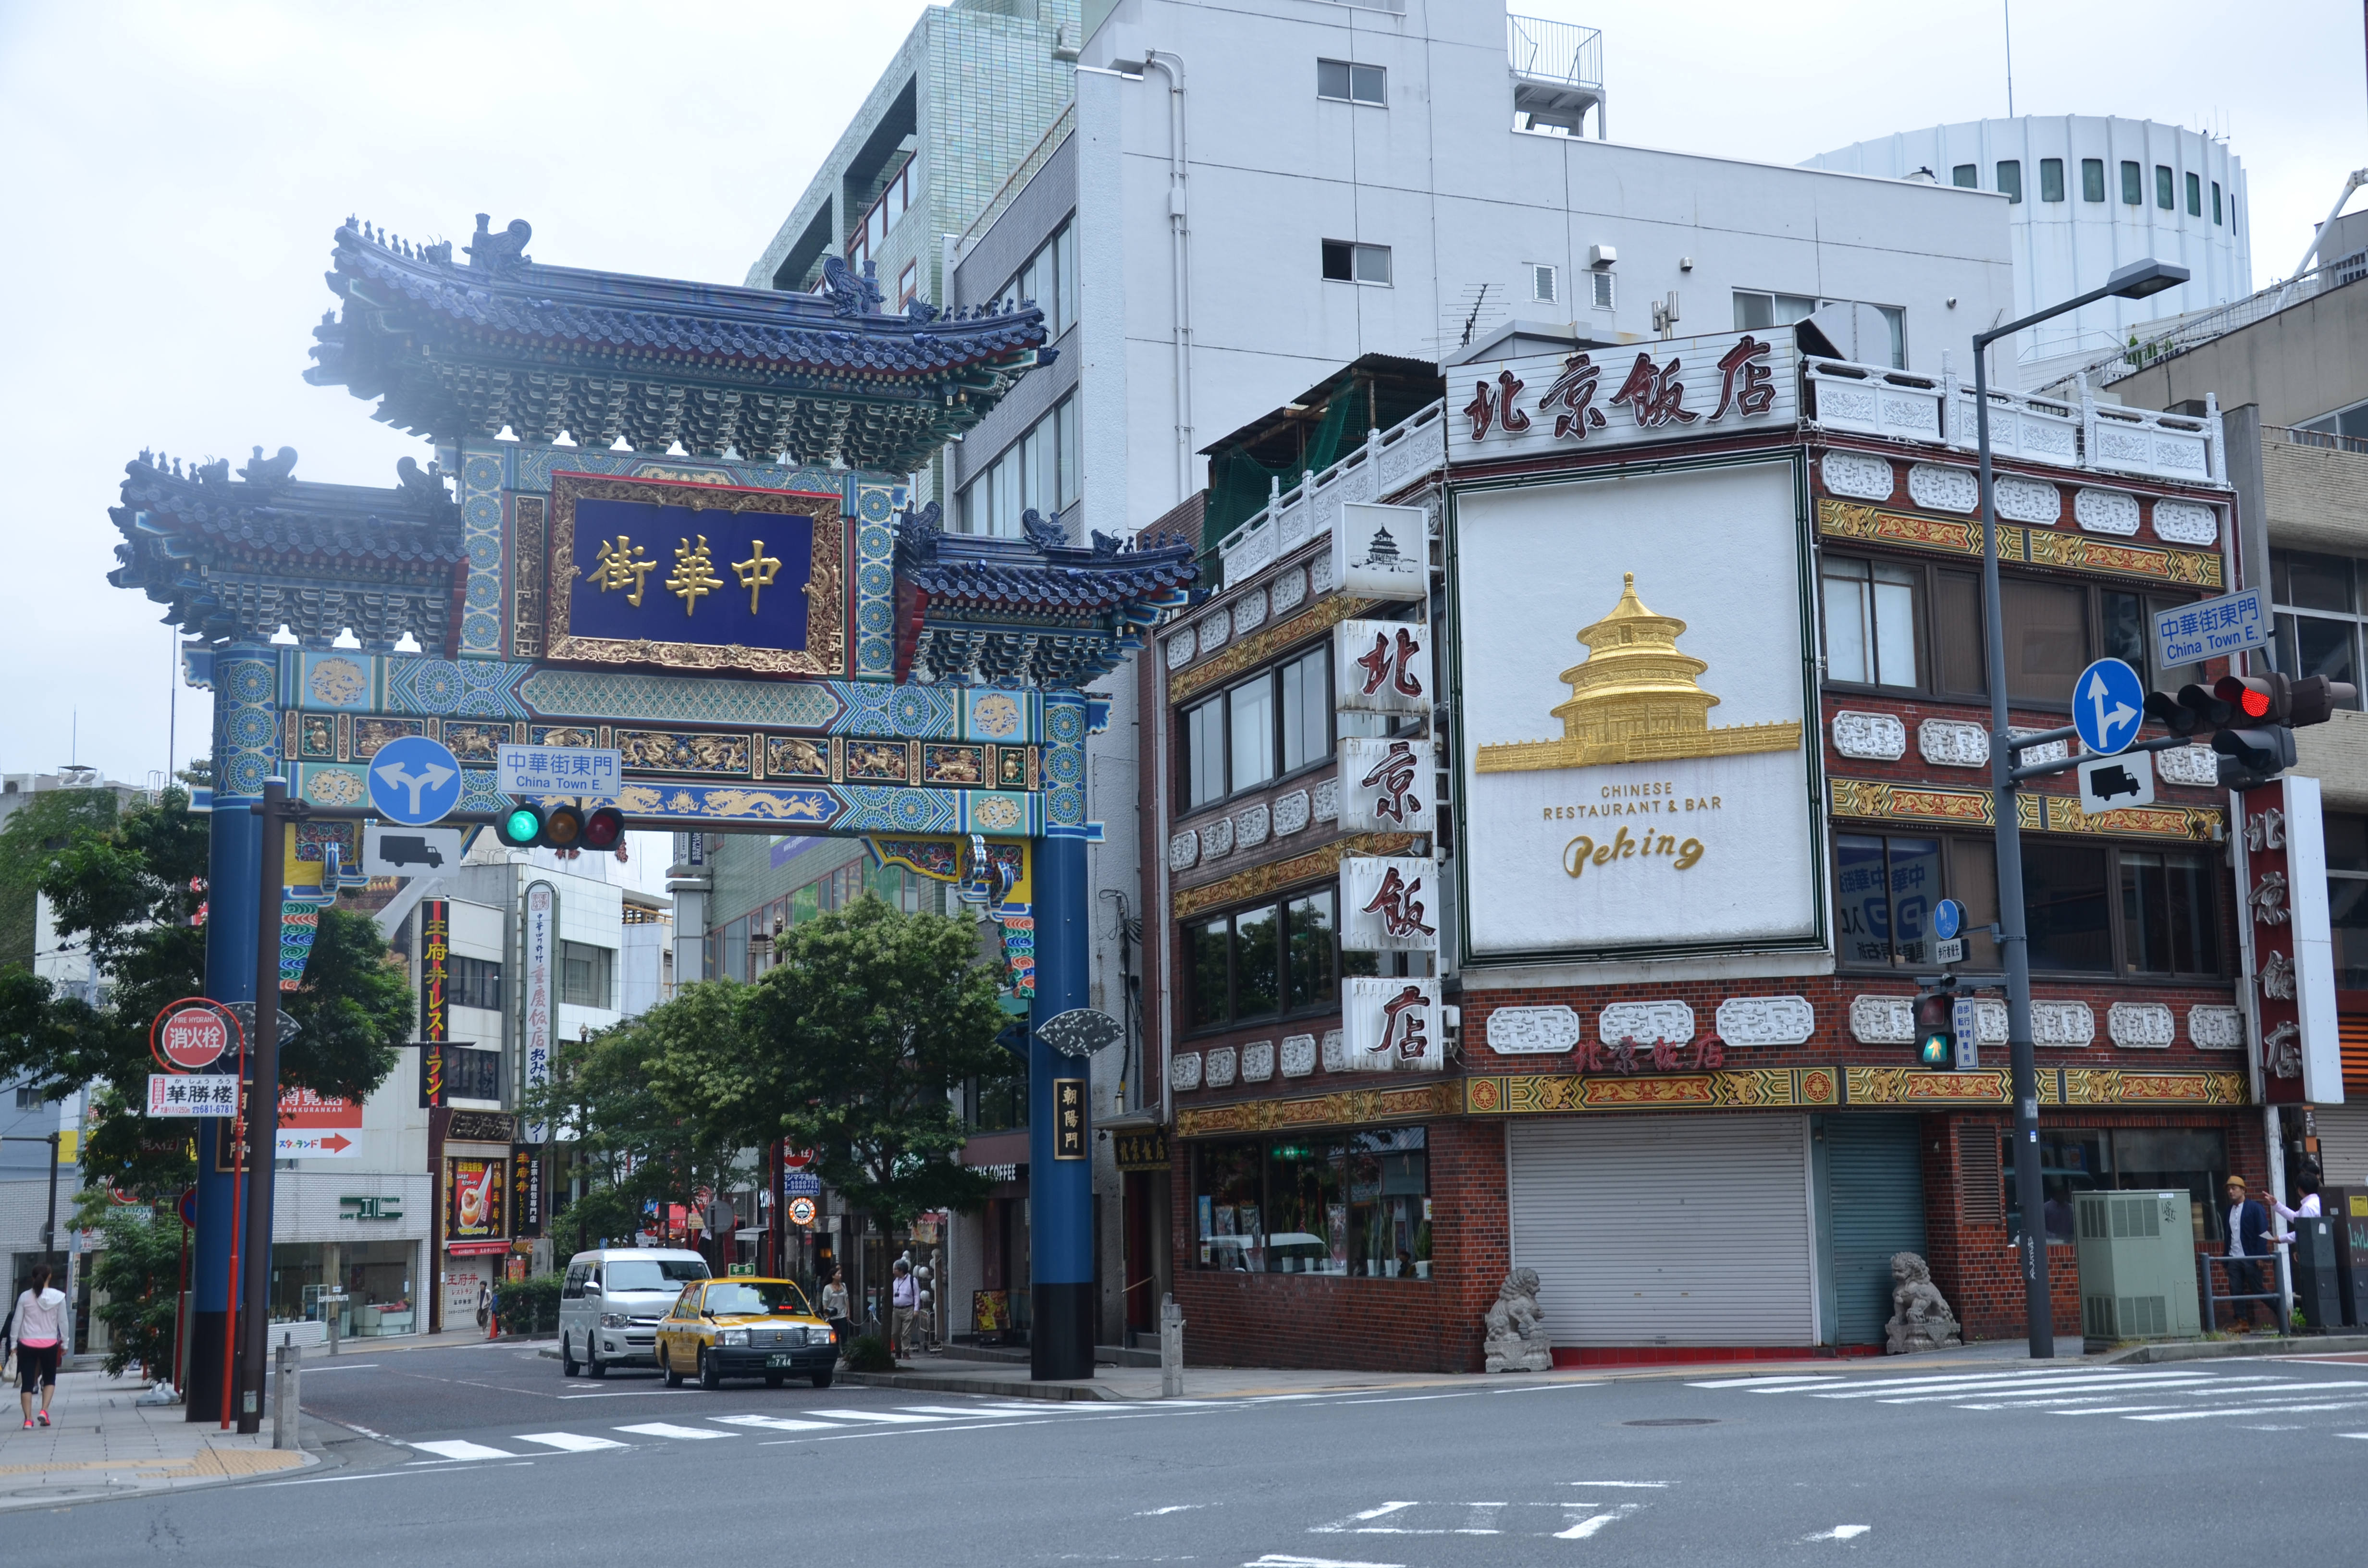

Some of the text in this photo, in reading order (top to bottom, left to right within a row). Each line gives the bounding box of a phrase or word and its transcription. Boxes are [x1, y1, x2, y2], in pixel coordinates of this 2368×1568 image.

[1464, 335, 1776, 442] 北京飯店
[586, 535, 783, 616] 中華街
[2160, 598, 2259, 642] 中華街東門
[2167, 626, 2258, 660] China Town E.
[507, 751, 612, 777] 中華街東門
[516, 775, 603, 790] China Town E.
[1601, 782, 1672, 798] CHINESE
[1543, 796, 1722, 821] RESTAURANT & BAR
[1357, 627, 1437, 1061] 北京飯店
[1563, 825, 1705, 878] Peking
[1938, 944, 1960, 960] 歩行者優先
[2243, 808, 2302, 1079] 北京飯店
[529, 963, 548, 1047] 重慶飯店
[170, 1026, 222, 1049] 消火栓
[1573, 1031, 1724, 1076] 北京飯店
[166, 1085, 234, 1104] 華勝楼
[199, 1105, 233, 1114] 681-6781
[1062, 1086, 1079, 1149] 朝陽門
[447, 1273, 478, 1286] 王府井
